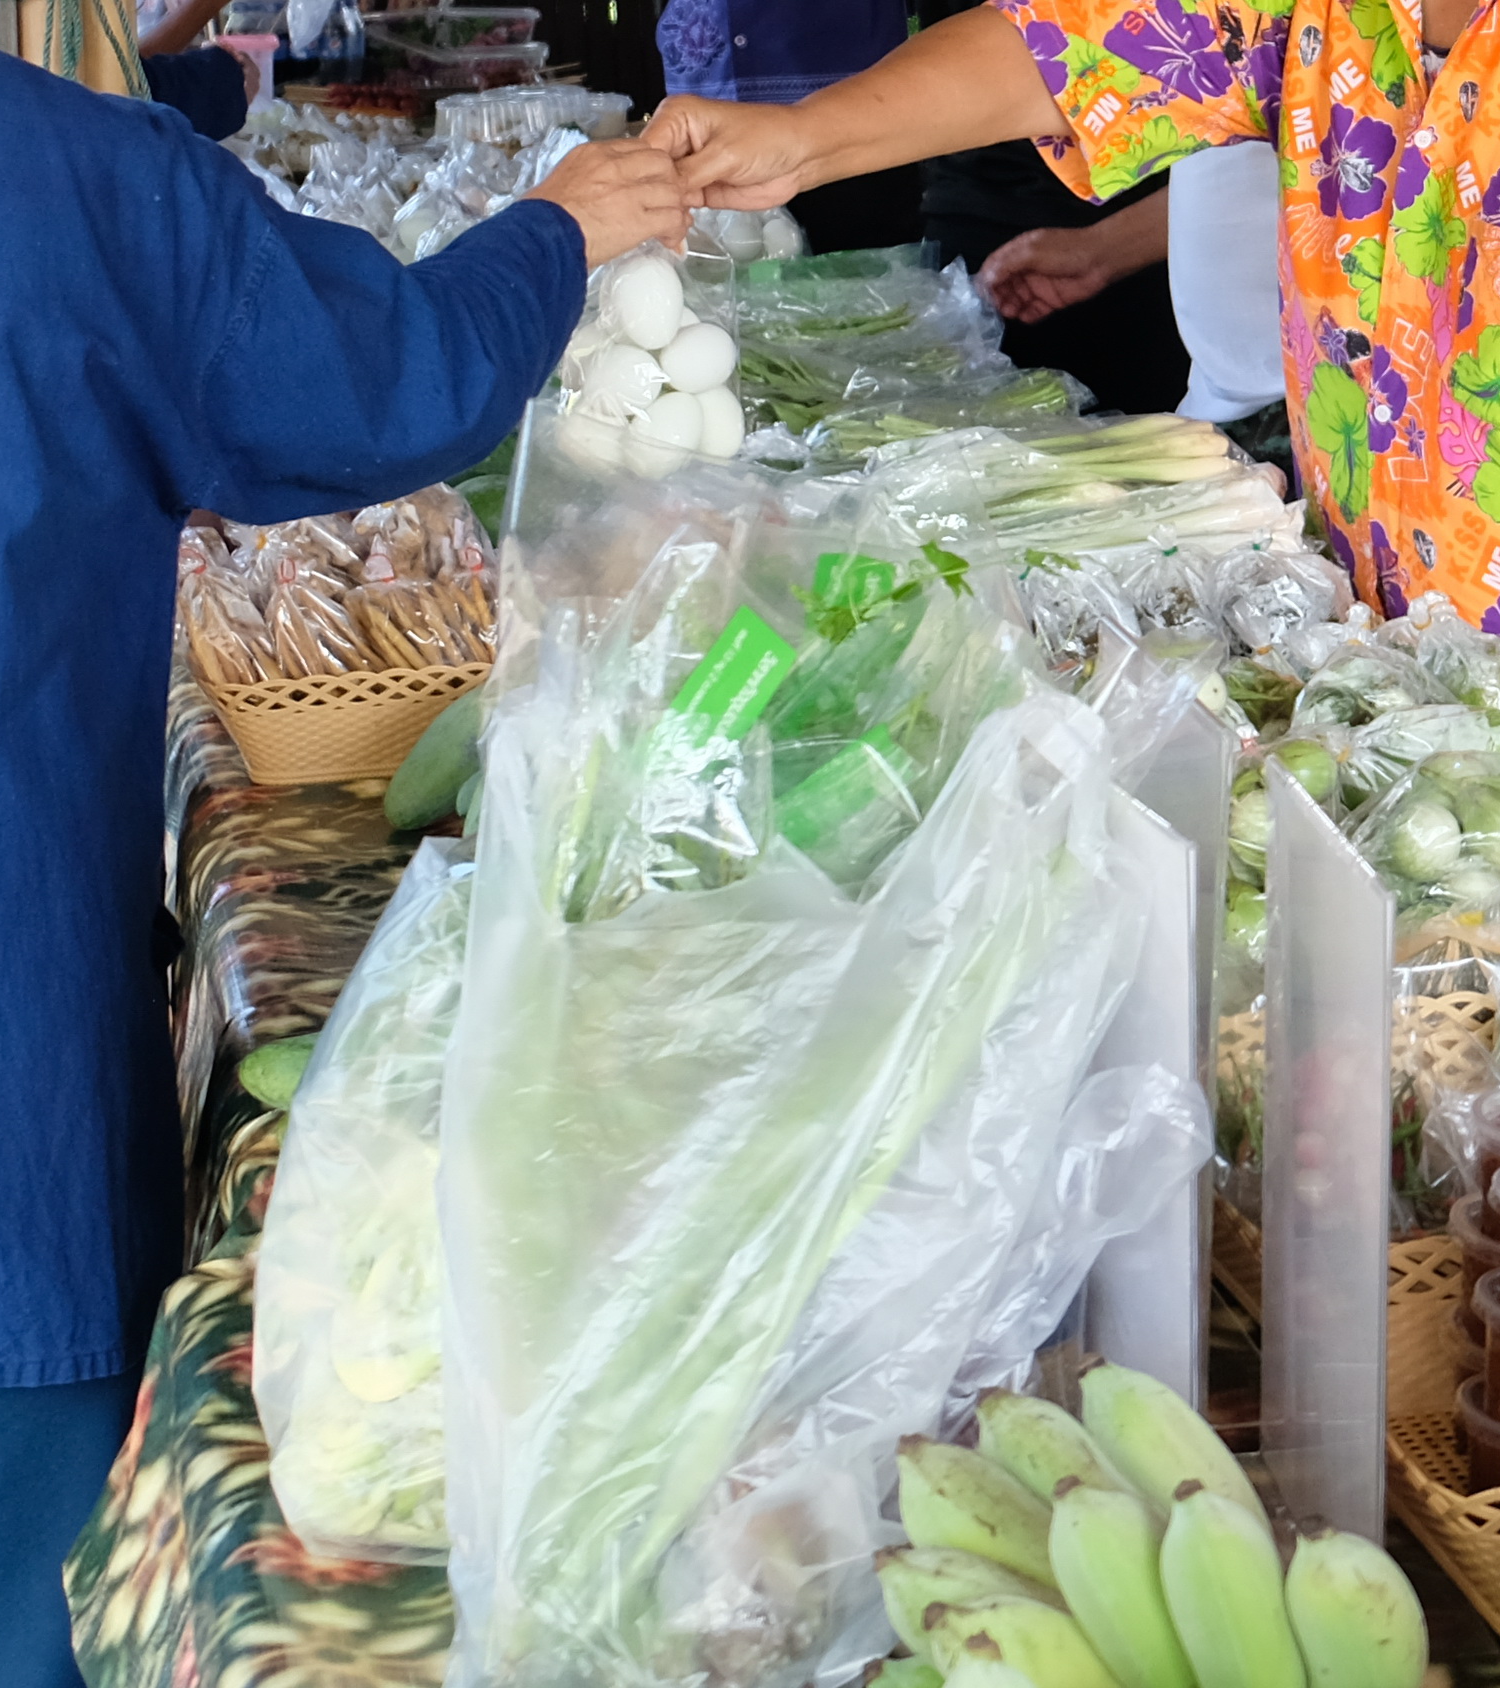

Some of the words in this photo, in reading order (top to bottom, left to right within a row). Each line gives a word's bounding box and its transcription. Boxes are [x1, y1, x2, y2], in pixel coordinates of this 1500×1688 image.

[1329, 58, 1365, 104] ME
[1082, 92, 1122, 137] ME
[1290, 105, 1317, 155] ME
[1455, 160, 1481, 209] ME
